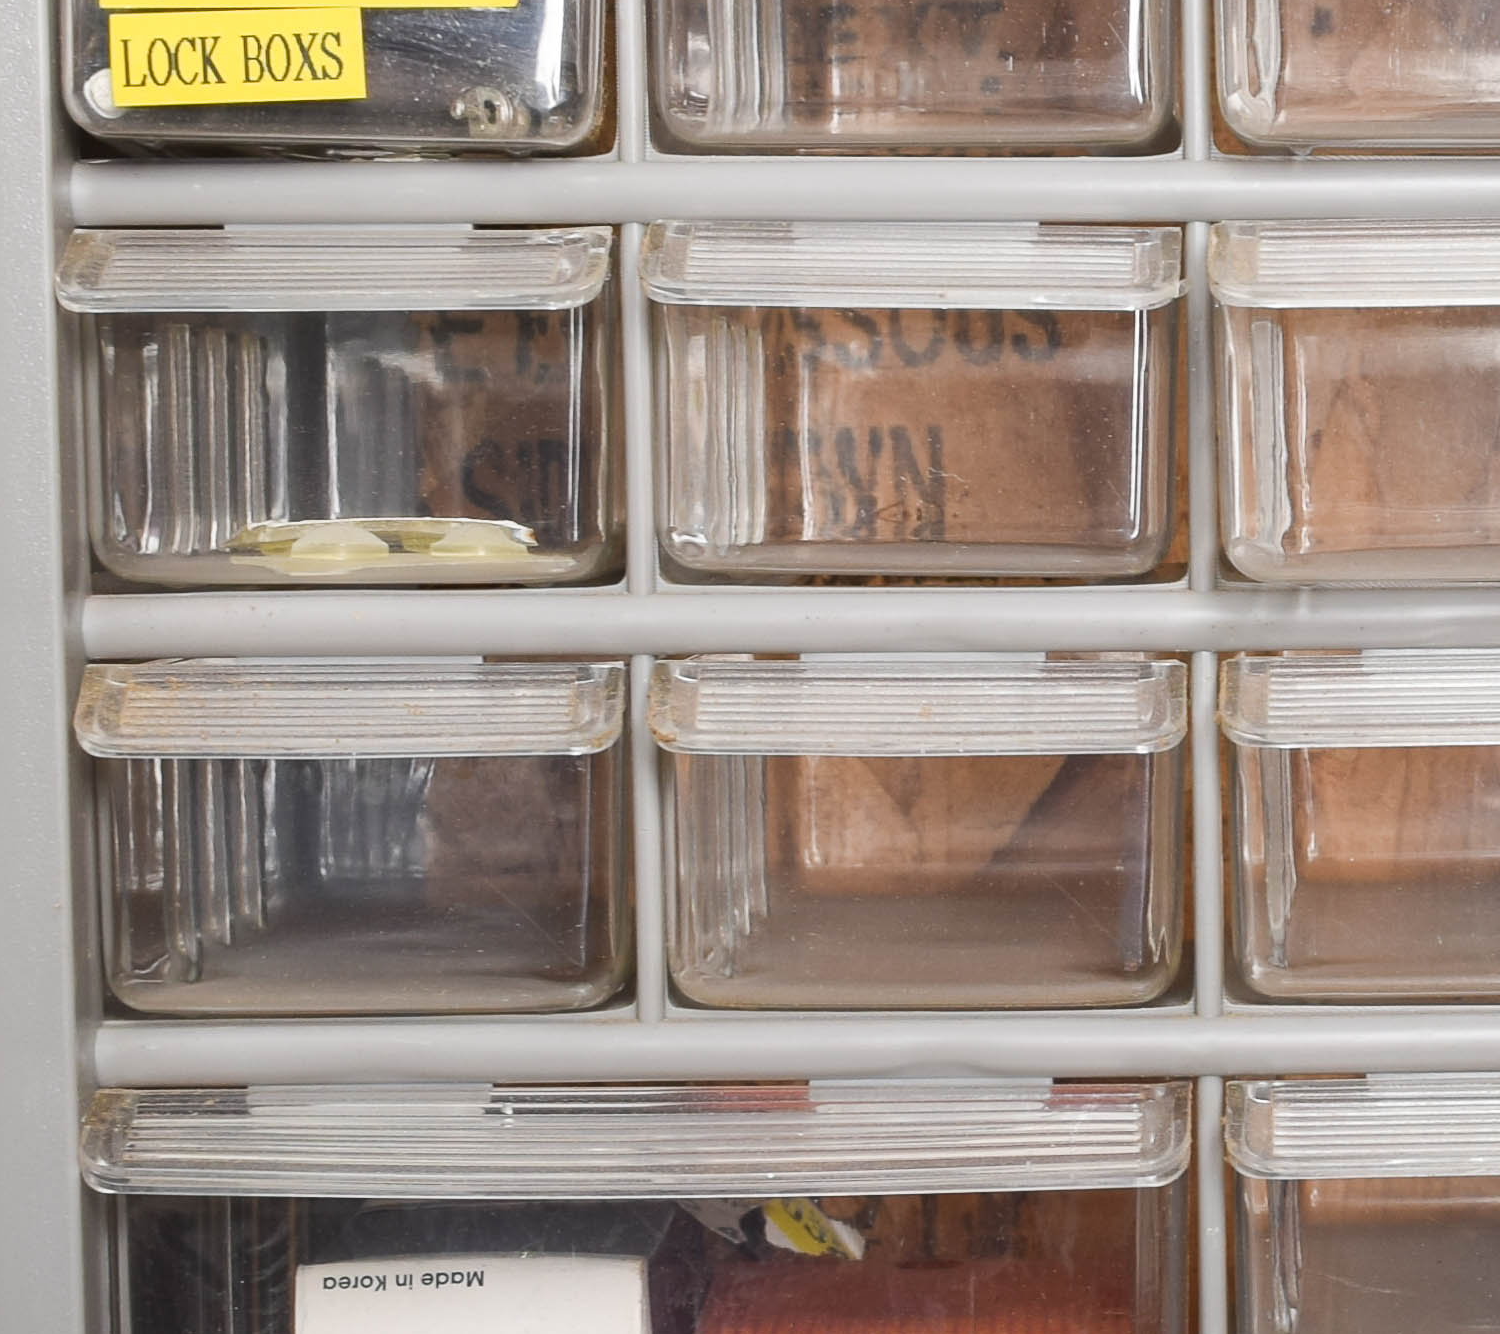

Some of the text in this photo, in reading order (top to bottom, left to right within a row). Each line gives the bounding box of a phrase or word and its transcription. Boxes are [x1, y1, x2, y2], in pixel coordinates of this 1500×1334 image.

[121, 33, 343, 87] LOCK BOXS
[323, 1271, 484, 1292] Made in Korea
